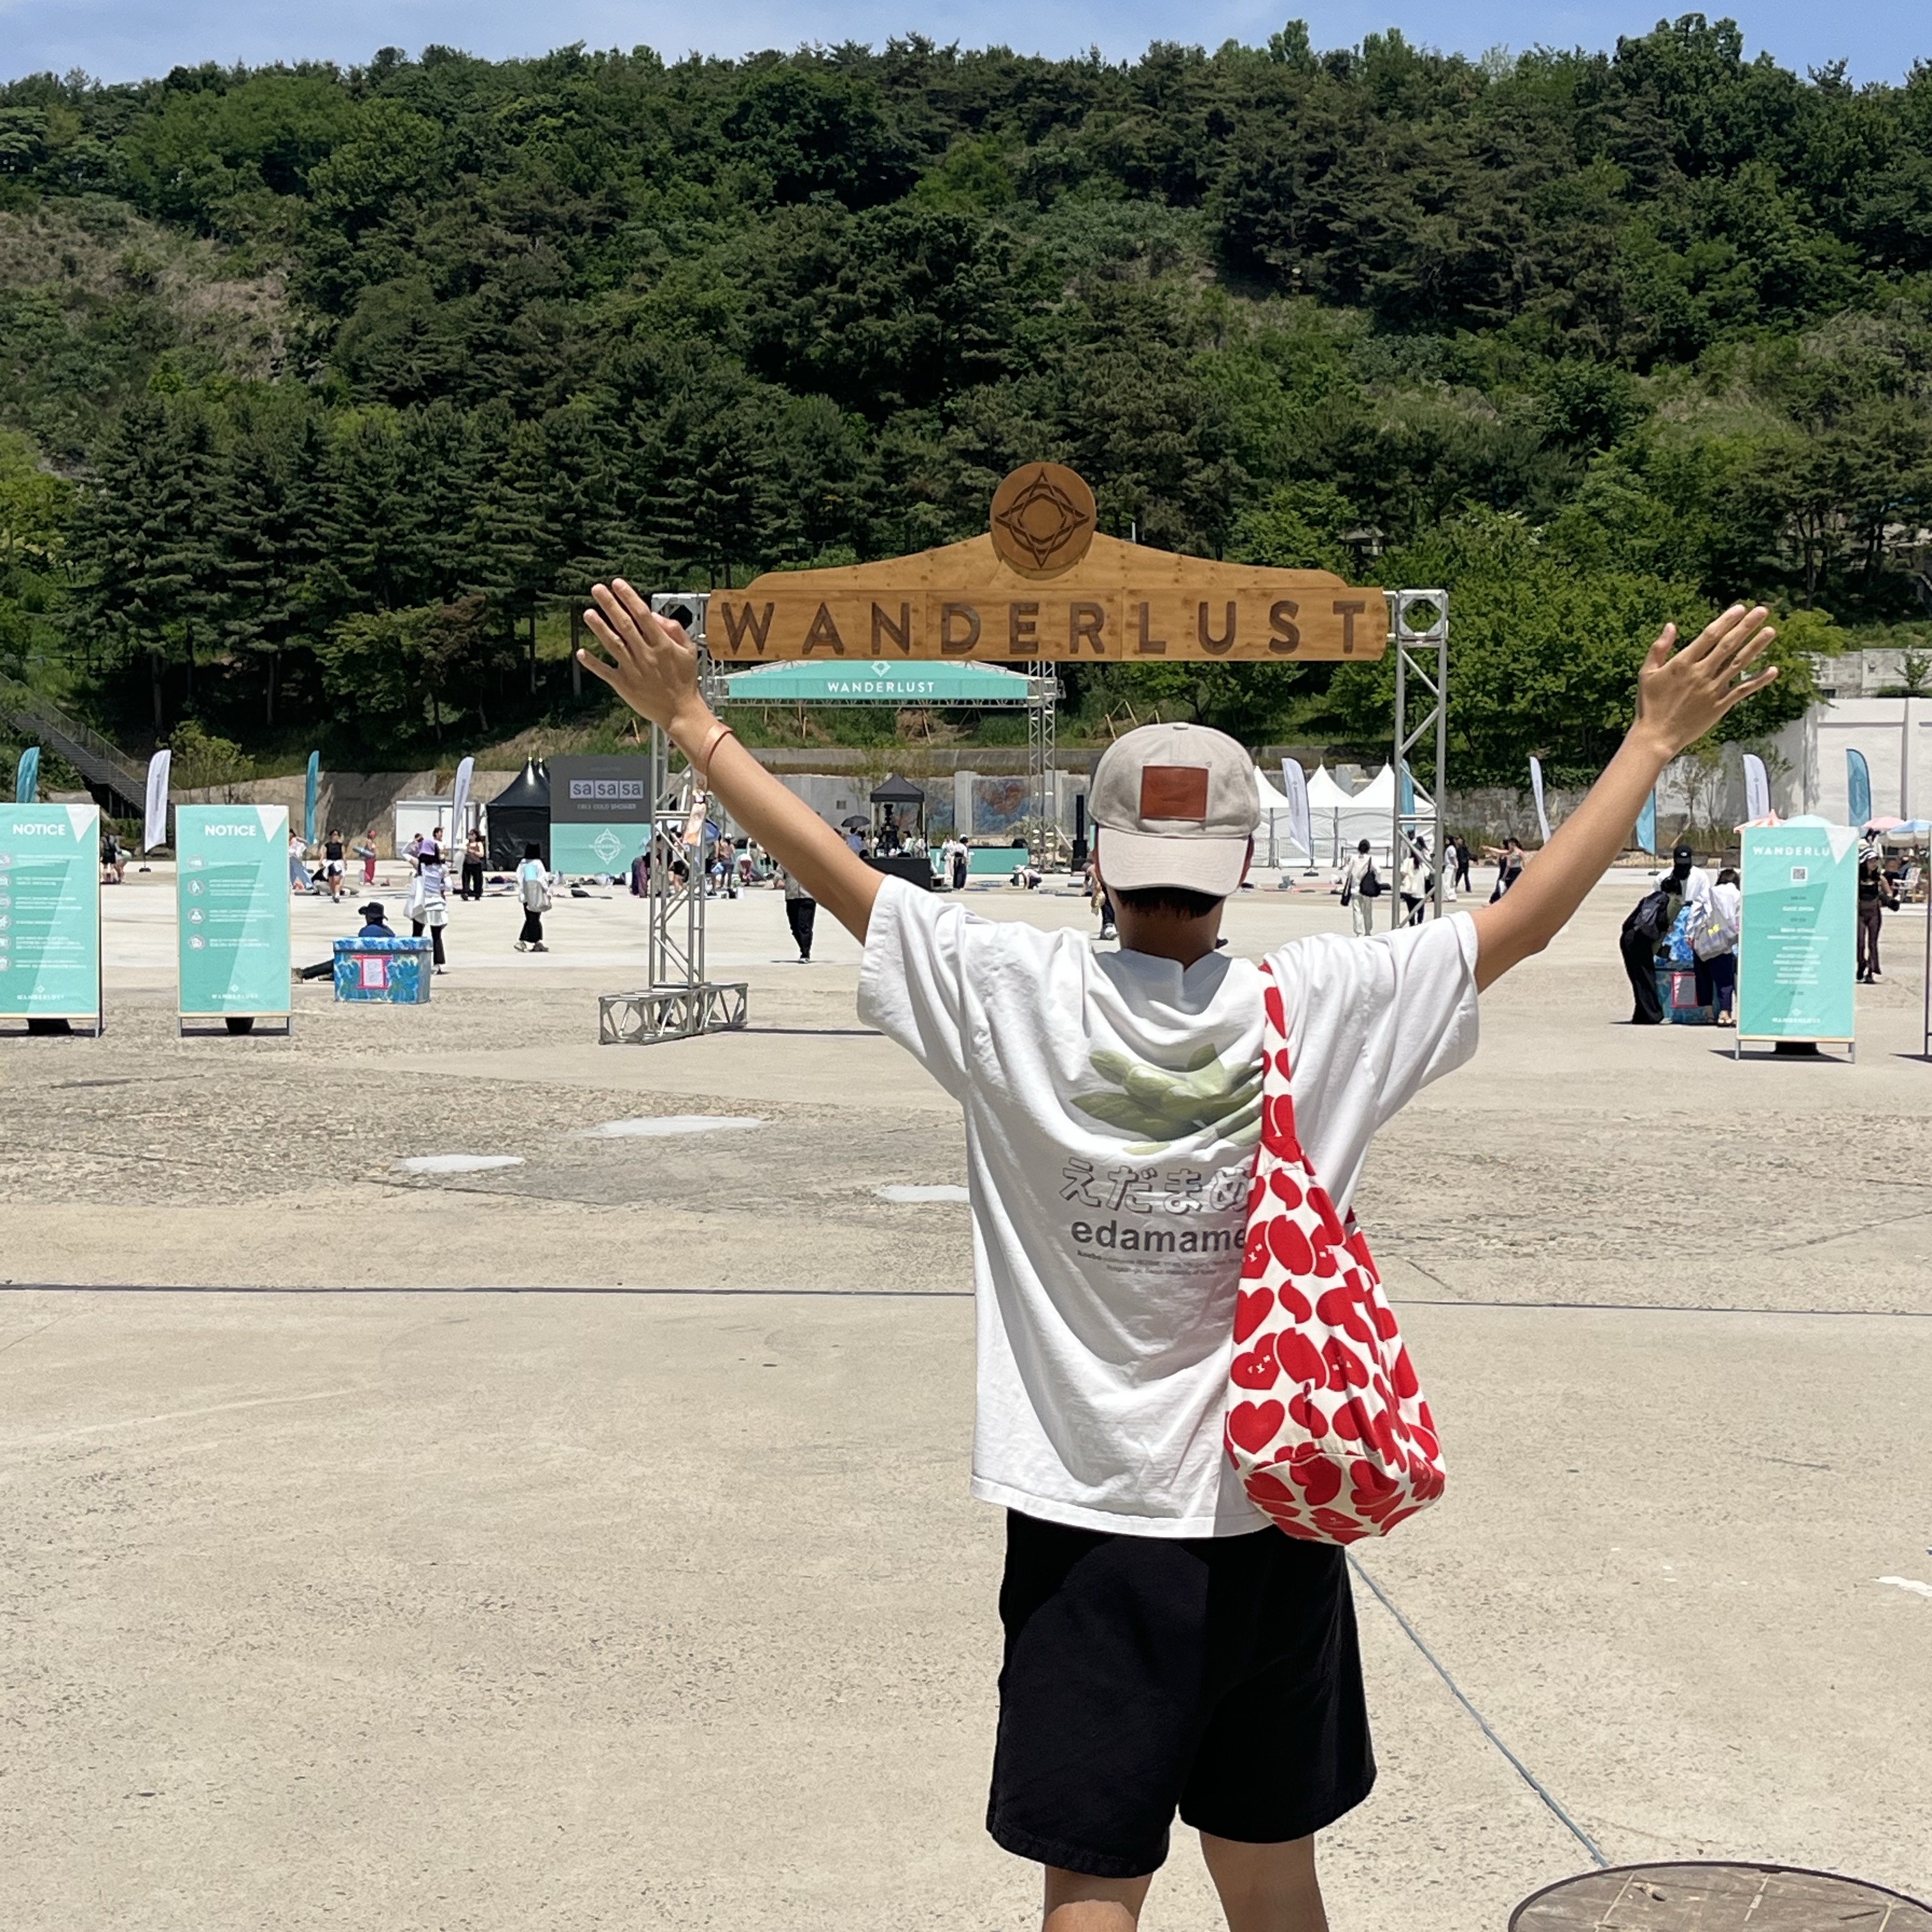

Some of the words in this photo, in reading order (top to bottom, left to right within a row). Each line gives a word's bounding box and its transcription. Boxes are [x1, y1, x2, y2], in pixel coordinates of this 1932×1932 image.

[721, 600, 1367, 656] WANDERLUST
[827, 681, 935, 693] WANDERLUST
[12, 823, 66, 836] NOTICE
[204, 824, 257, 836] NOTICE
[1059, 1156, 1249, 1215] えだまめ
